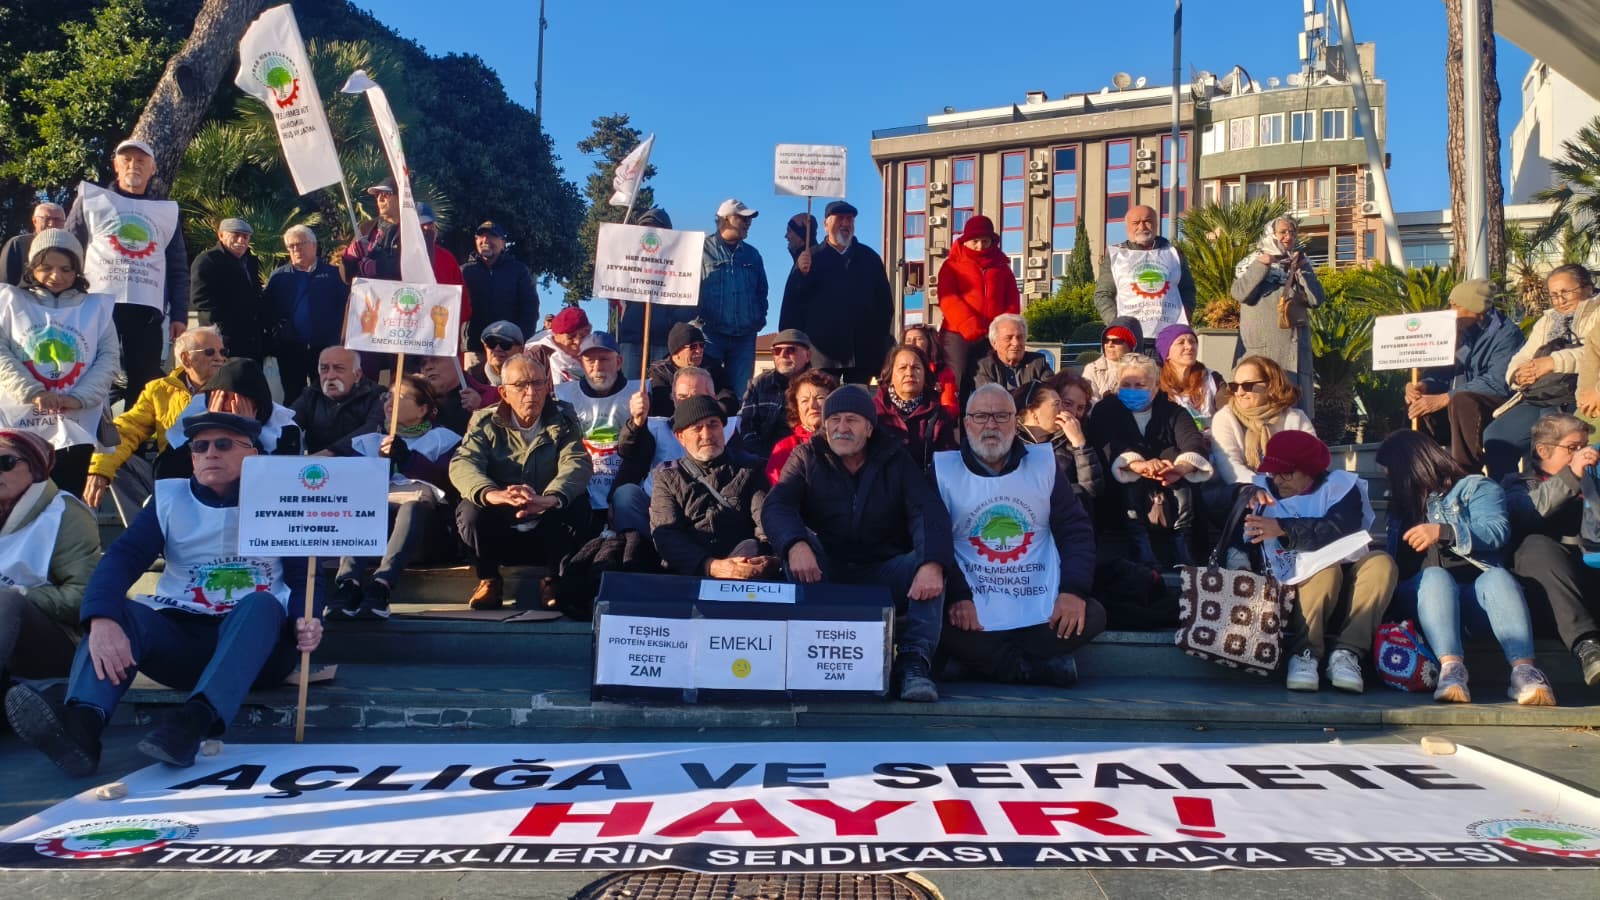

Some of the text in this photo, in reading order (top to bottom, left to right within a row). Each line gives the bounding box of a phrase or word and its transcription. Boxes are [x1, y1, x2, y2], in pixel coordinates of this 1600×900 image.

[390, 328, 413, 338] SÖZ
[301, 494, 348, 503] EMEKLİYE
[255, 510, 304, 518] SEYYANEN
[355, 510, 376, 518] ZAM
[288, 524, 339, 532] İSTİYORUZ.
[249, 538, 377, 546] TÜM EMEKLİLERİN SENDİKASI
[964, 563, 1046, 574] TÜM EMEKLİLERİN
[978, 575, 1030, 586] SENDİKASI
[720, 583, 782, 594] EMEKLİ
[970, 585, 1048, 598] ANTALYA ŞUBESİ
[628, 624, 670, 638] TEŞHİS
[816, 629, 856, 642] TEŞHİS
[608, 636, 688, 649] PROTEİN EKSİKLİĞİ
[709, 634, 772, 650] EMEKLİ
[807, 645, 864, 660] STRES
[628, 654, 666, 665] REÇETE
[630, 665, 662, 678] ZAM
[816, 662, 854, 672] REÇETE
[824, 672, 846, 680] ZAM
[166, 758, 1487, 799] AÇLIĞA VE SEFALETE
[156, 843, 1519, 866] TÜM EMEKLİLERİN SENDİKASI ANTALYA ŞUBESİ
